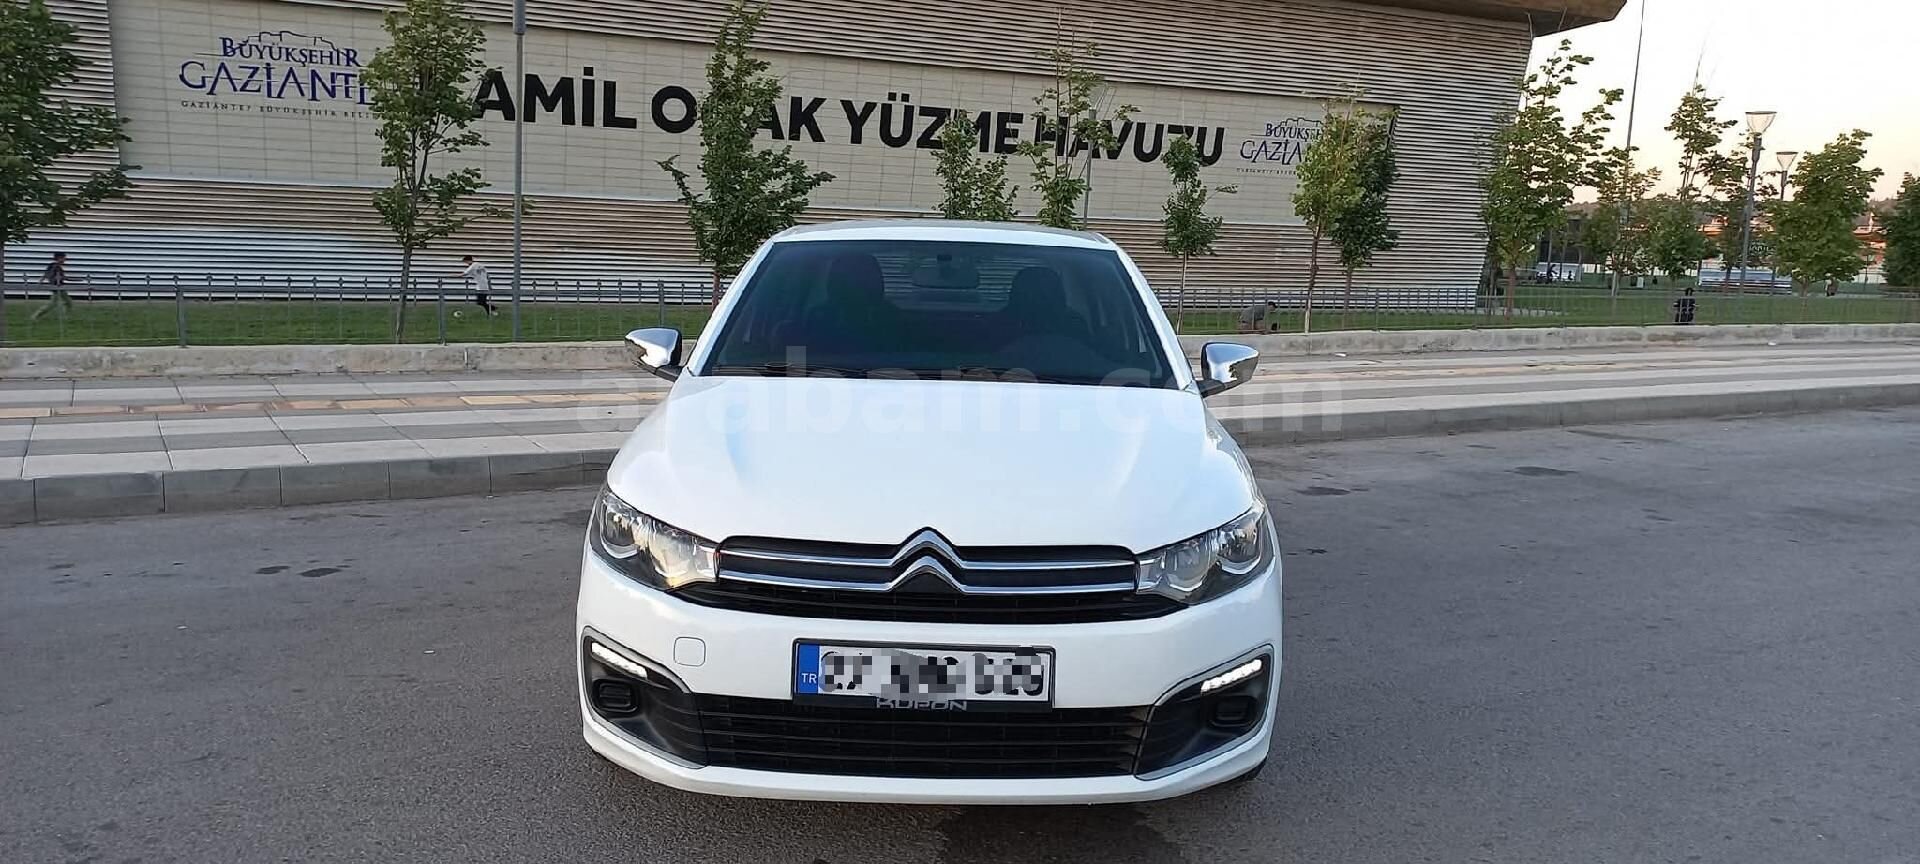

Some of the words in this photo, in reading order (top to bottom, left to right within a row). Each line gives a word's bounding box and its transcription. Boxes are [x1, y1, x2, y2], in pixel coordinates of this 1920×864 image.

[179, 60, 378, 105] GAZİANTE
[651, 85, 828, 143] OAK
[801, 672, 818, 684] TR
